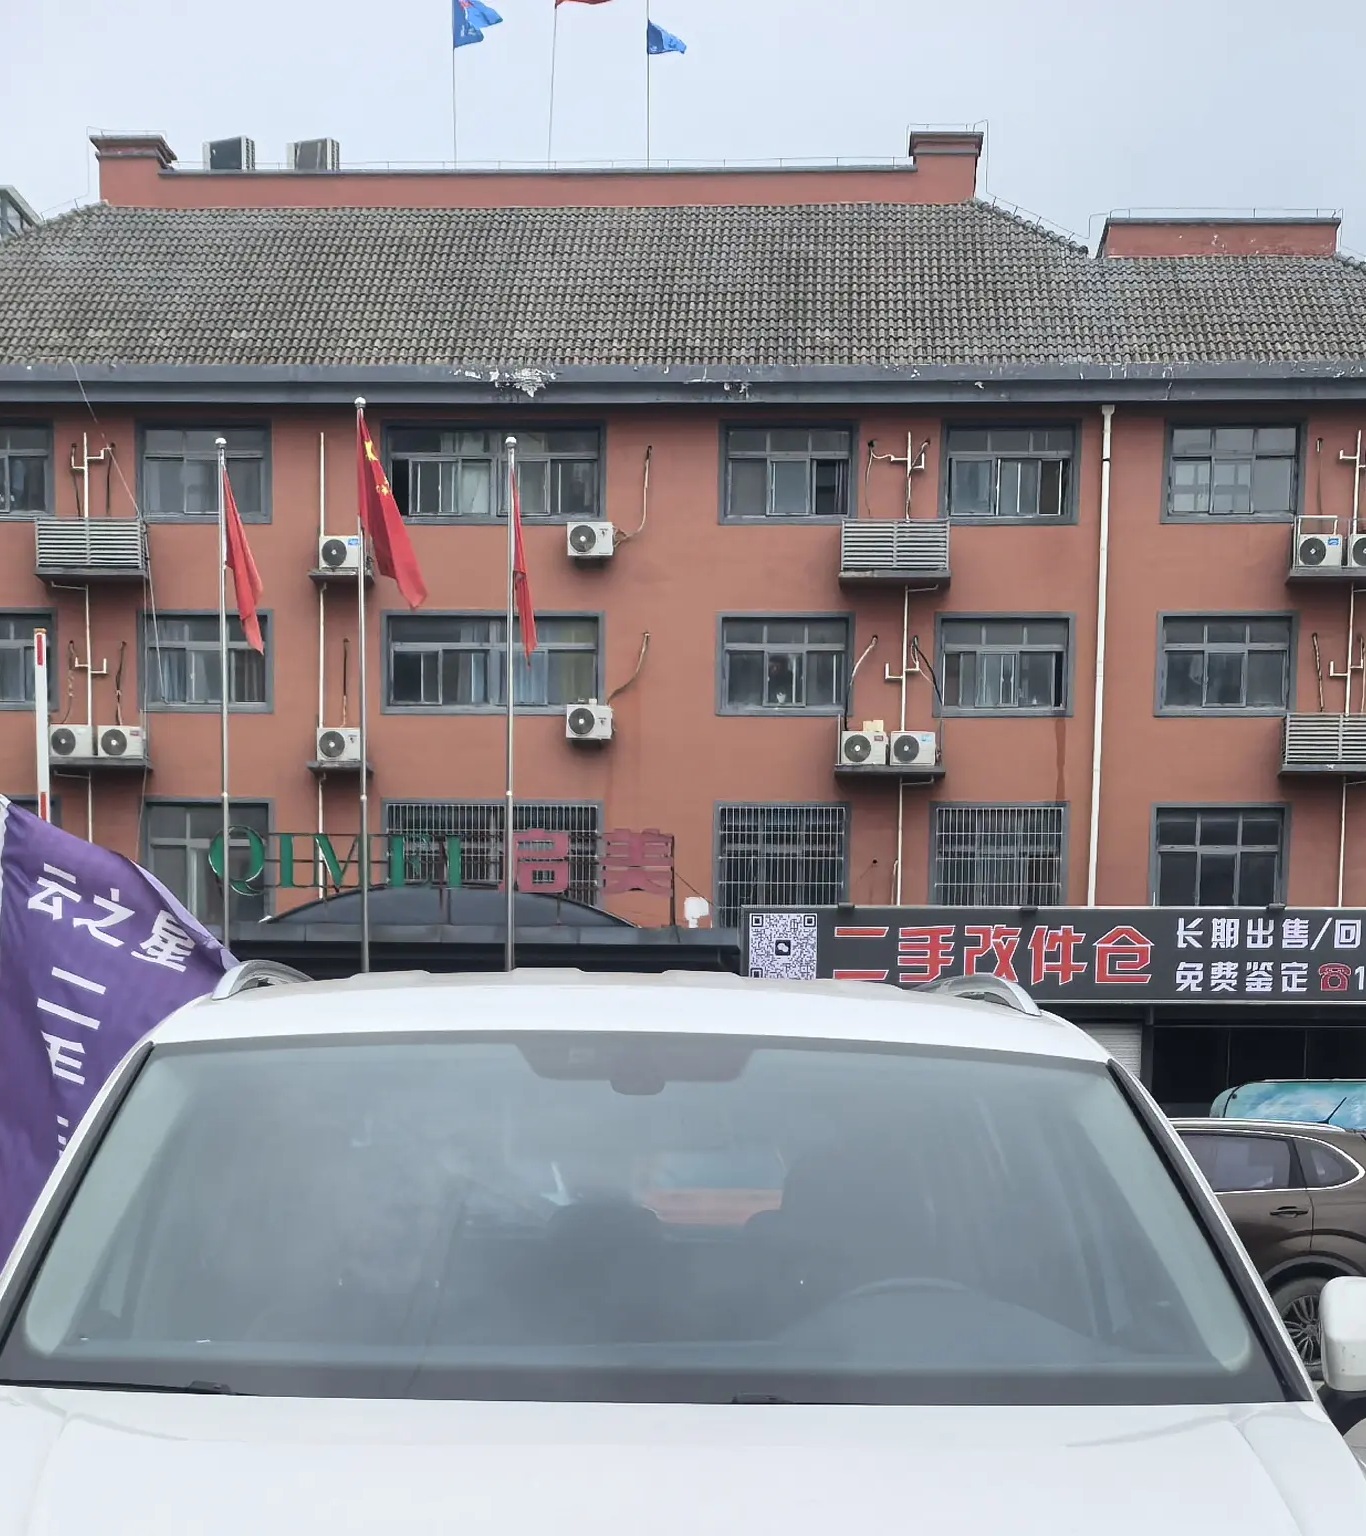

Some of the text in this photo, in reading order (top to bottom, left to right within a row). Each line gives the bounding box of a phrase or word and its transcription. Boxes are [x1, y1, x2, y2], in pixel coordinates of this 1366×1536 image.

[28, 863, 197, 973] 云之星
[833, 924, 1155, 985] 二手改件仓
[1175, 961, 1309, 993] 免费鉴定
